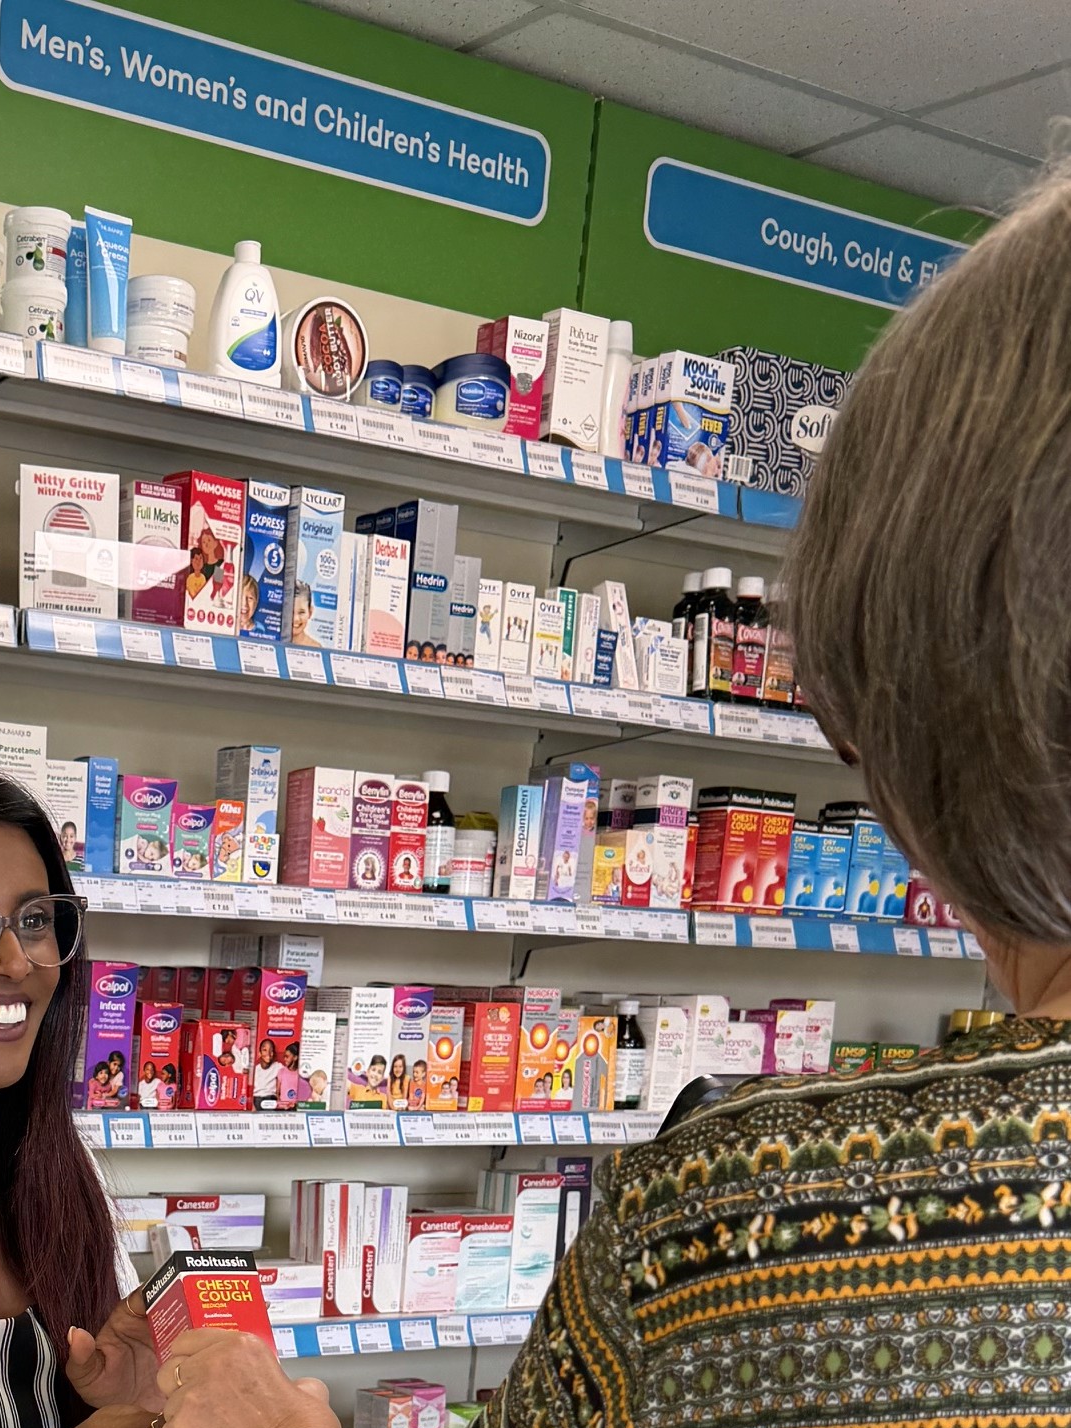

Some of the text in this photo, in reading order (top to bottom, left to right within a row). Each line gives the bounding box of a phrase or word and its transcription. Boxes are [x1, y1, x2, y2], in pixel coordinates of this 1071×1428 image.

[20, 19, 530, 189] Men's, Women's and Children's Health
[761, 218, 938, 285] Cough, Cold & Fl
[245, 288, 264, 305] QV
[513, 329, 544, 343] Nizoral
[690, 374, 725, 397] SOOTHE
[34, 473, 106, 493] Nitty Gritty
[195, 480, 241, 499] VAMOUSSE
[38, 487, 103, 500] NitFree Comb
[136, 505, 179, 525] Full Marks
[250, 514, 285, 529] EXPRESS
[303, 522, 333, 535] Original
[376, 540, 397, 556] Derbac
[416, 575, 444, 585] Hedrin
[361, 785, 388, 797] Benylin
[135, 791, 163, 805] Calpol
[181, 816, 202, 829] Calpol
[732, 813, 759, 824] CHESTY
[731, 822, 756, 832] COUGH
[99, 981, 131, 994] Calpol
[100, 1002, 125, 1011] Infant
[150, 1016, 175, 1028] Calpol
[421, 1220, 460, 1231] Canestest
[186, 1255, 247, 1267] Robitussin
[145, 1264, 175, 1302] Robitussin
[197, 1280, 250, 1292] CHESTY
[199, 1290, 253, 1302] COUGH
